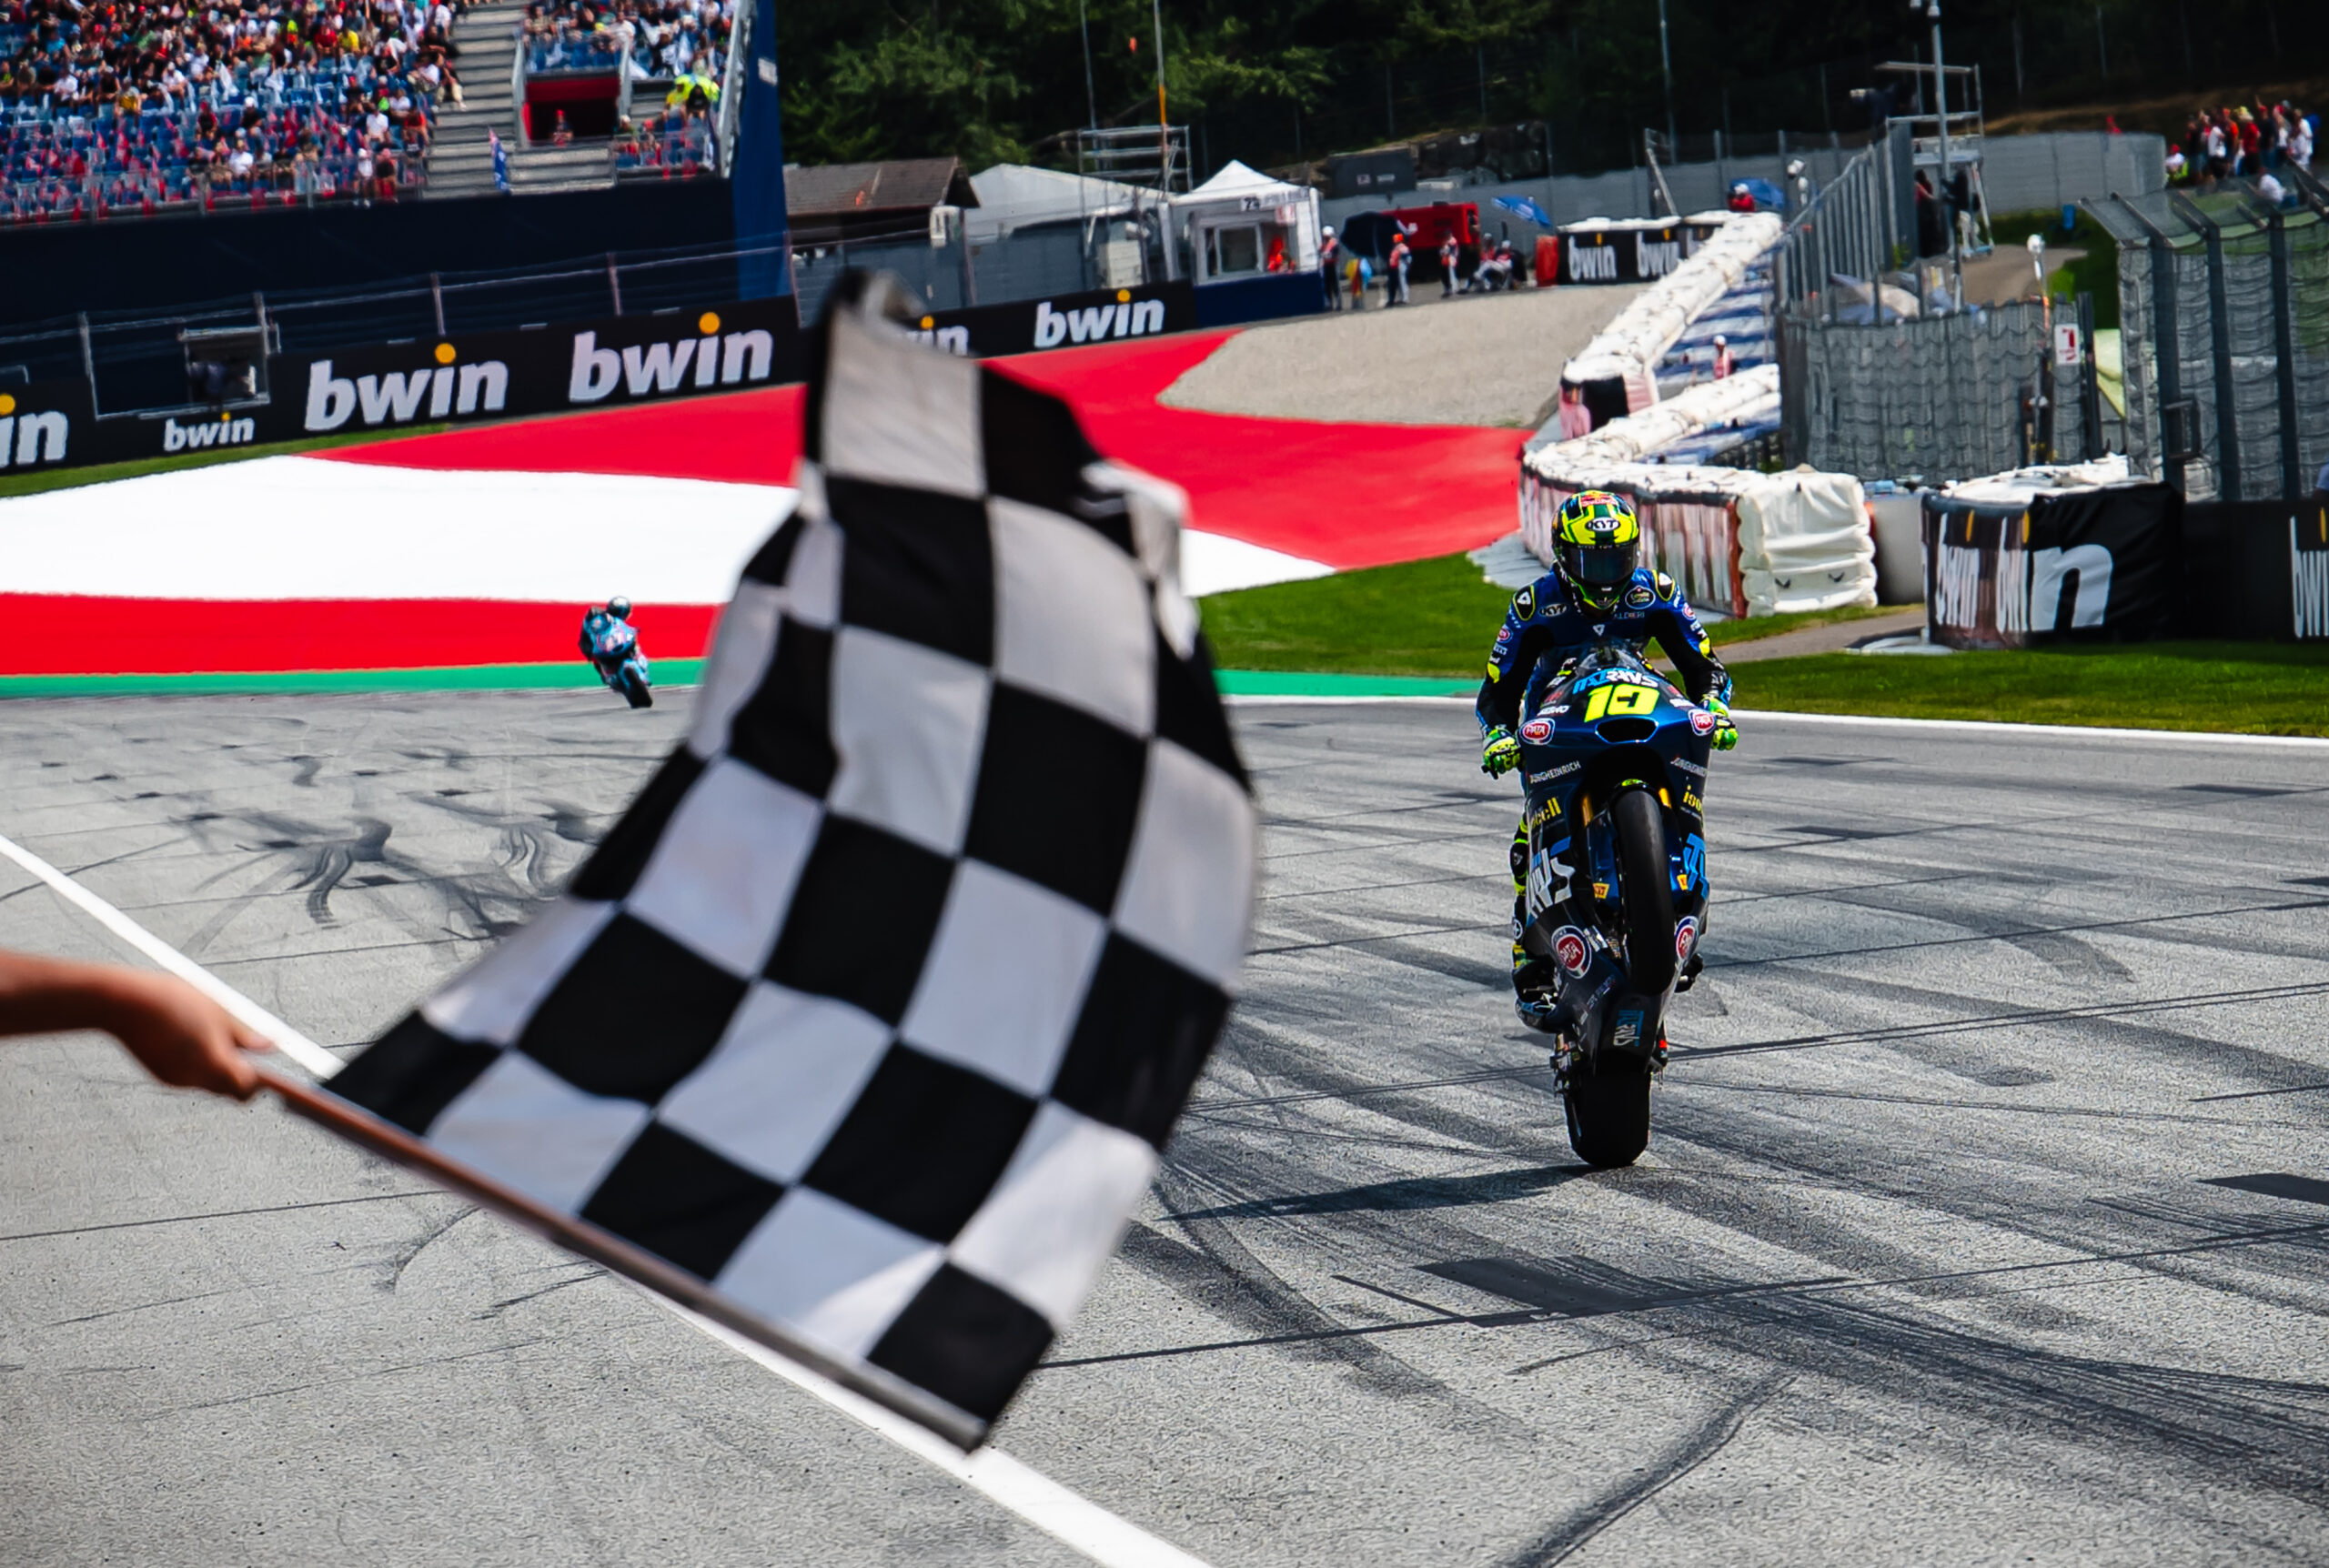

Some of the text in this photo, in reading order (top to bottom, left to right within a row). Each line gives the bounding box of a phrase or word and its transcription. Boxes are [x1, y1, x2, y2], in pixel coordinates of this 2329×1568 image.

[1568, 233, 1617, 281] bwin
[1033, 288, 1164, 348] bwin
[569, 312, 772, 402] bwin
[304, 342, 509, 431] bwin
[0, 394, 68, 468] in
[164, 412, 255, 452] bwin
[1586, 518, 1620, 531] KYT
[2290, 508, 2329, 638] bwi
[1539, 604, 1567, 617] KYT
[1584, 684, 1659, 722] 10
